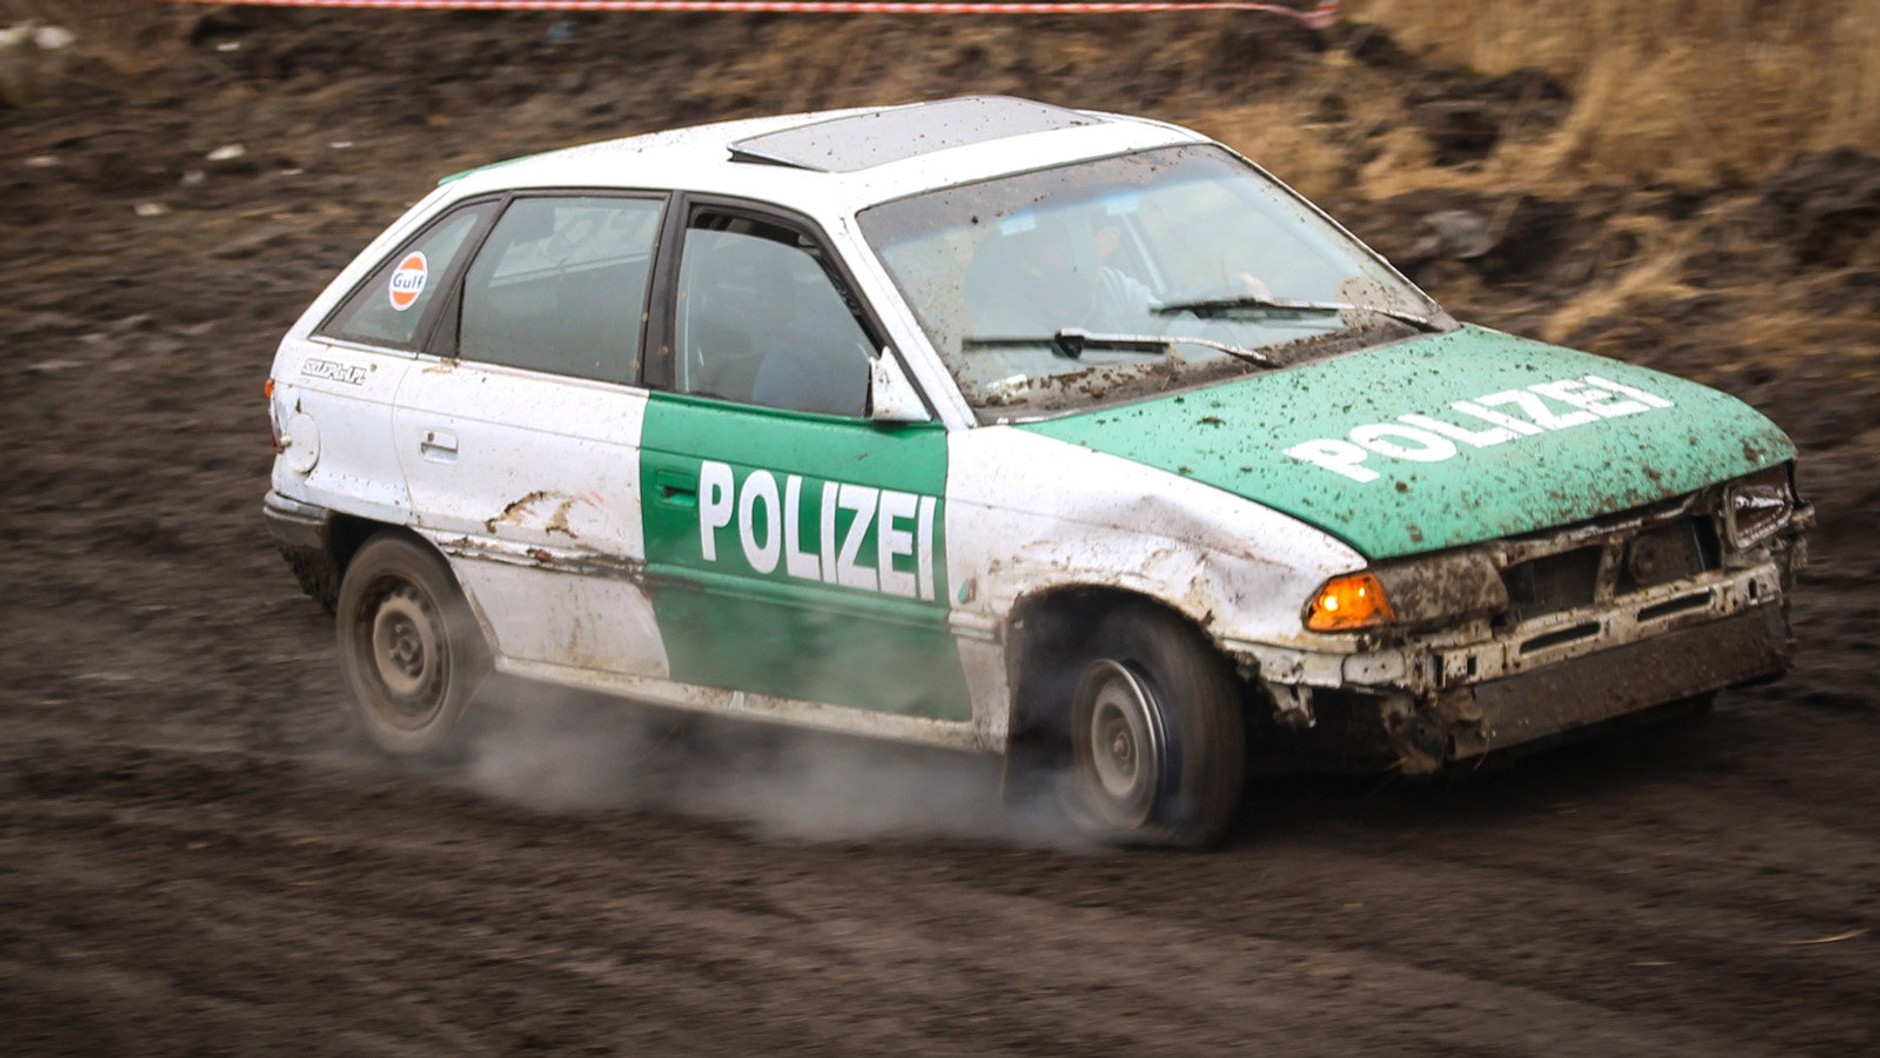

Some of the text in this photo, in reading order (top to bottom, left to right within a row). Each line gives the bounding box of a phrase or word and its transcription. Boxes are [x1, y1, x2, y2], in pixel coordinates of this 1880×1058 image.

[393, 272, 425, 289] Gulf
[1282, 375, 1675, 483] POLIZEI
[699, 459, 937, 600] POLIZEI
